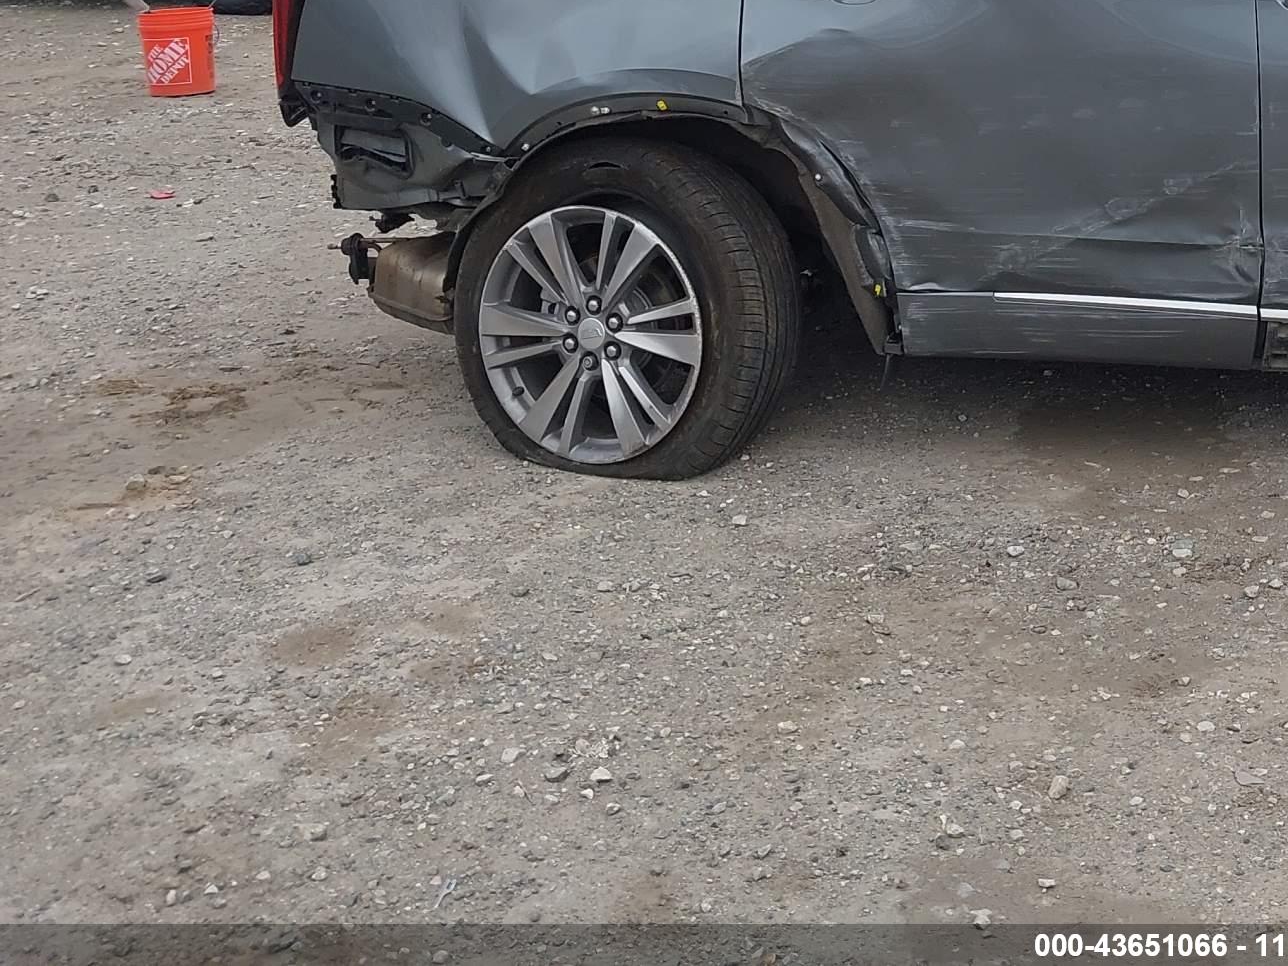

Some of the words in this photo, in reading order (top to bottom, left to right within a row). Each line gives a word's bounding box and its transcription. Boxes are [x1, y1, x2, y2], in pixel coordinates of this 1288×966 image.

[147, 39, 188, 84] HOME
[148, 44, 163, 62] THE
[160, 55, 189, 84] DEPOT
